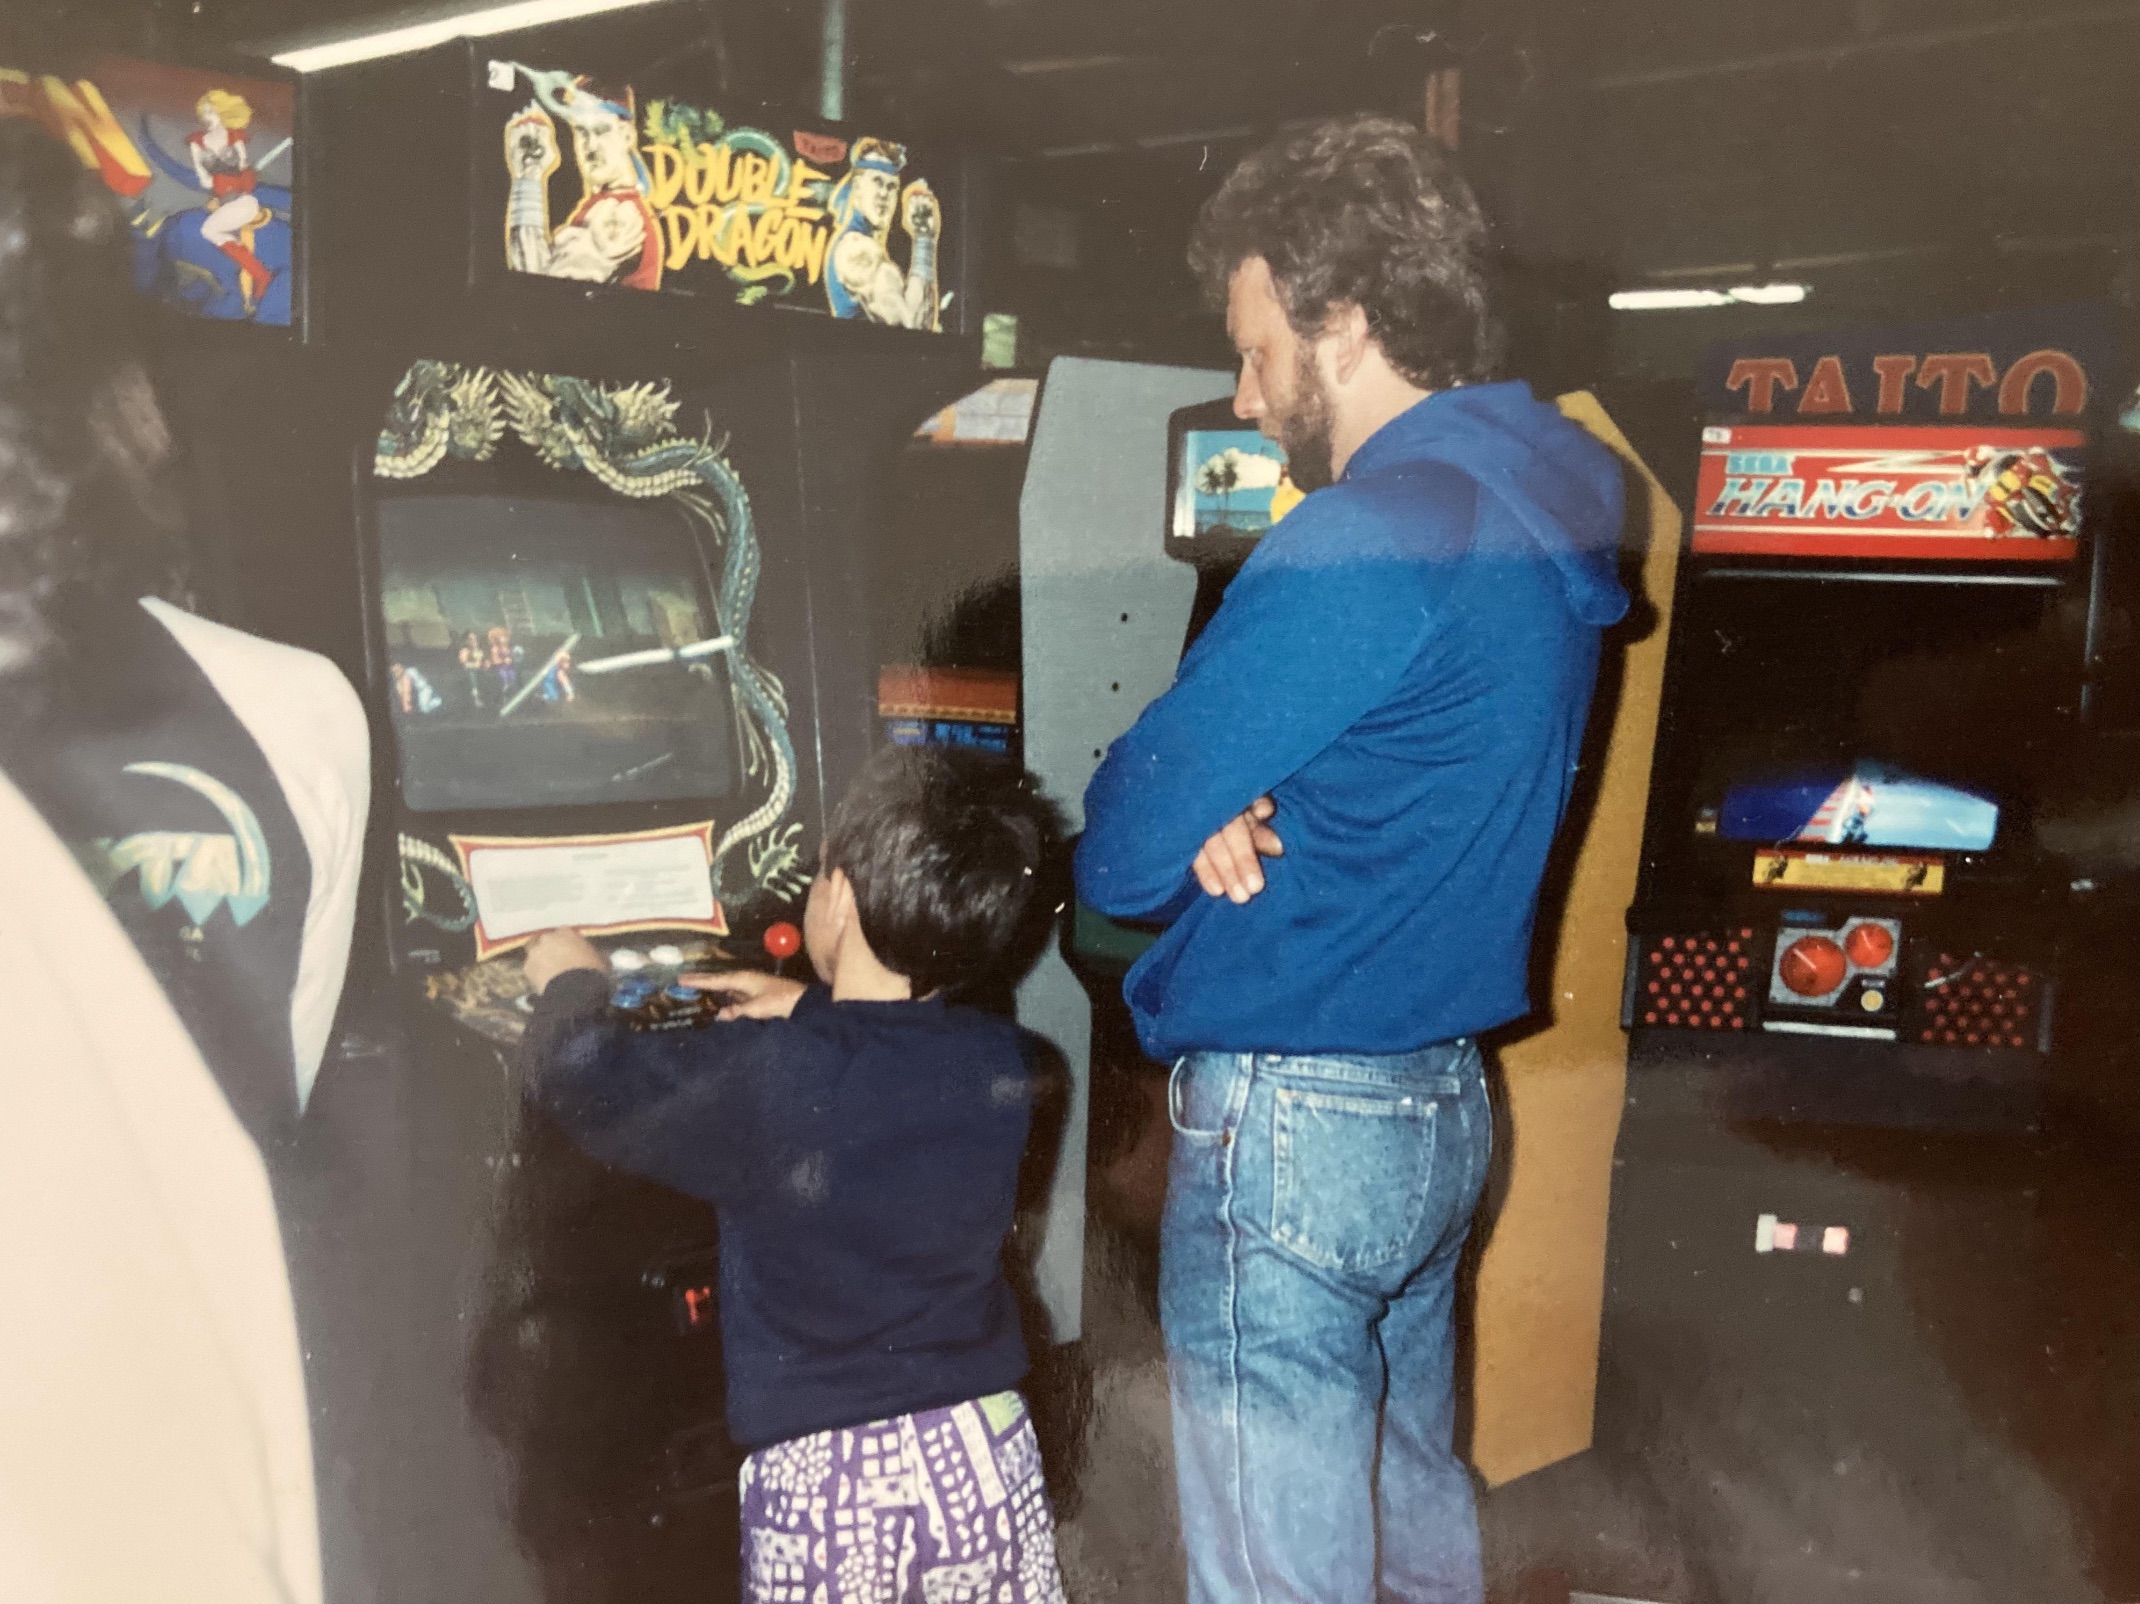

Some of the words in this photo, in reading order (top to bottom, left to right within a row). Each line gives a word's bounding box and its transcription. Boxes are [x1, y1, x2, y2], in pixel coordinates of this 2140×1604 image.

[642, 142, 834, 221] DOUBLE
[665, 205, 829, 286] DRAGON
[1726, 349, 2089, 415] TAITO
[1706, 474, 1989, 523] HANG-ON
